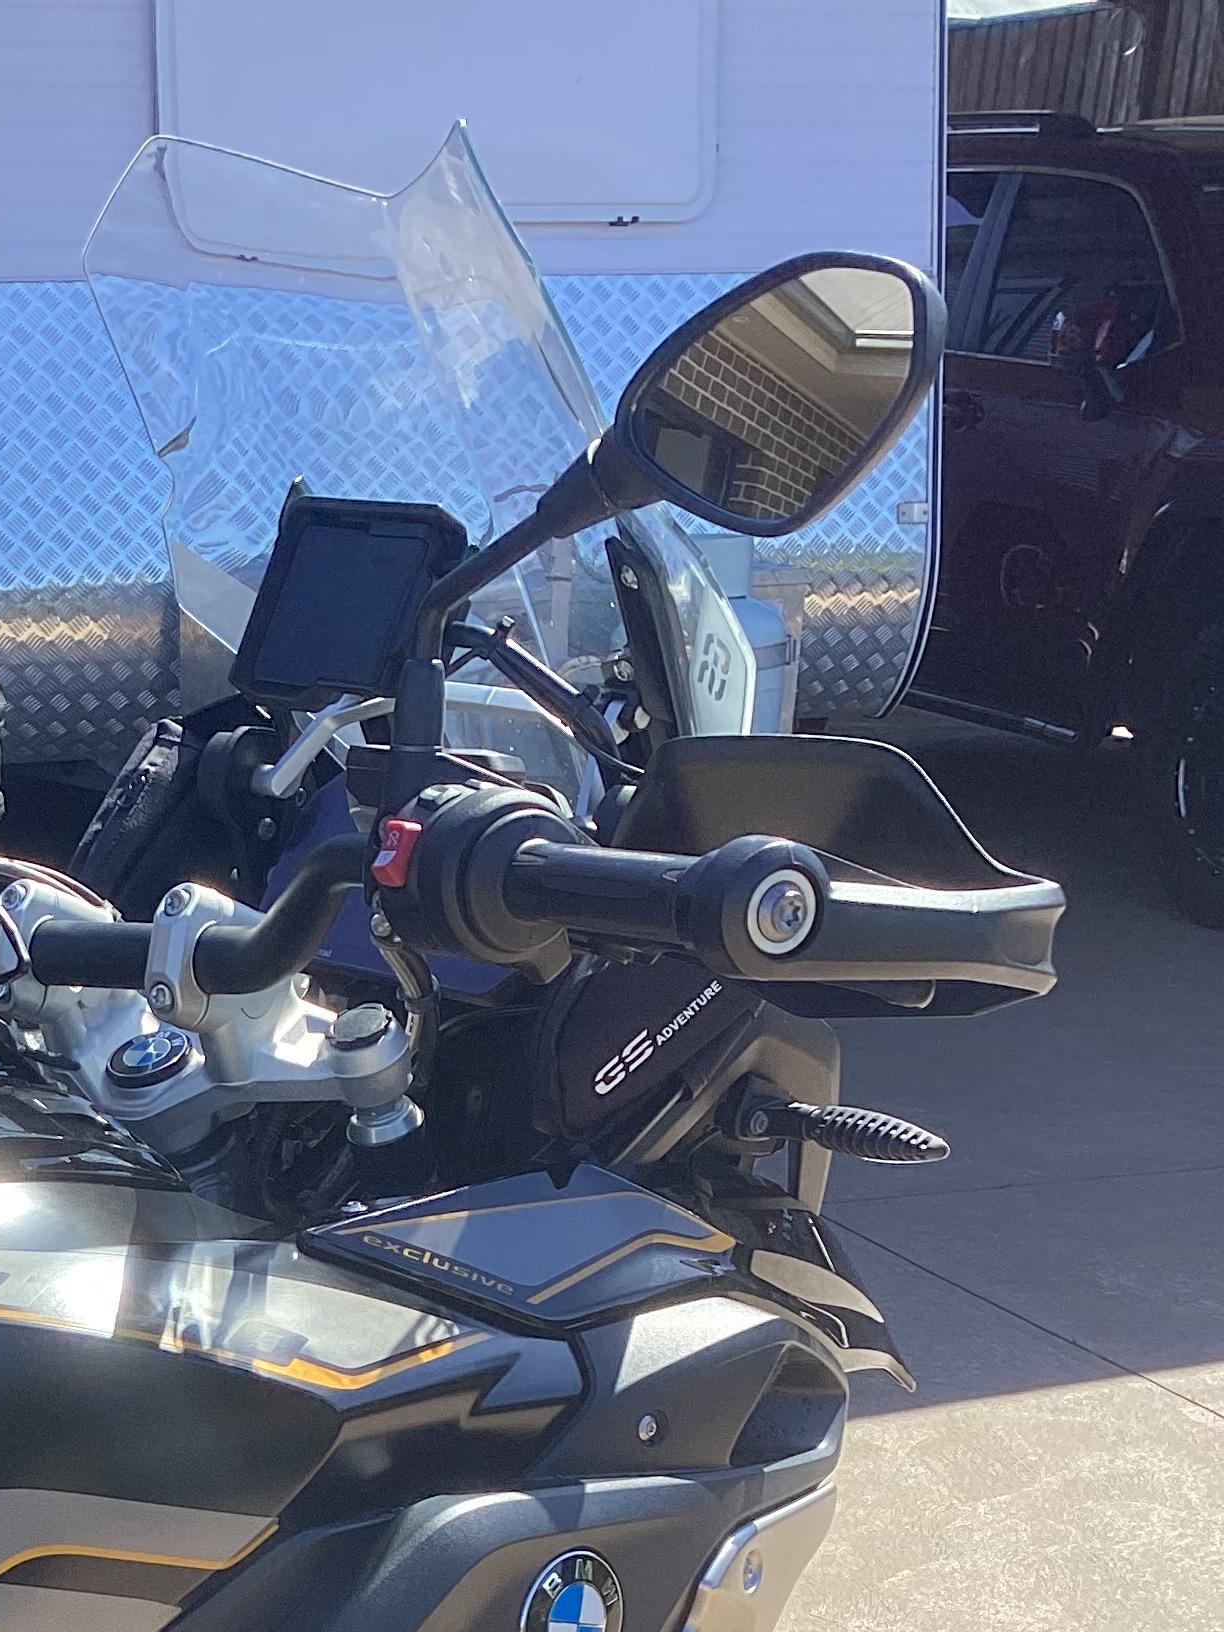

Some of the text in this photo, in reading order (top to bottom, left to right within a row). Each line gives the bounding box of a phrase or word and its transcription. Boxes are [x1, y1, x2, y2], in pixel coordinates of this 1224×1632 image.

[594, 980, 723, 1095] GS ADVENTURE
[362, 1234, 514, 1296] exclusive
[542, 1558, 619, 1606] BMW
